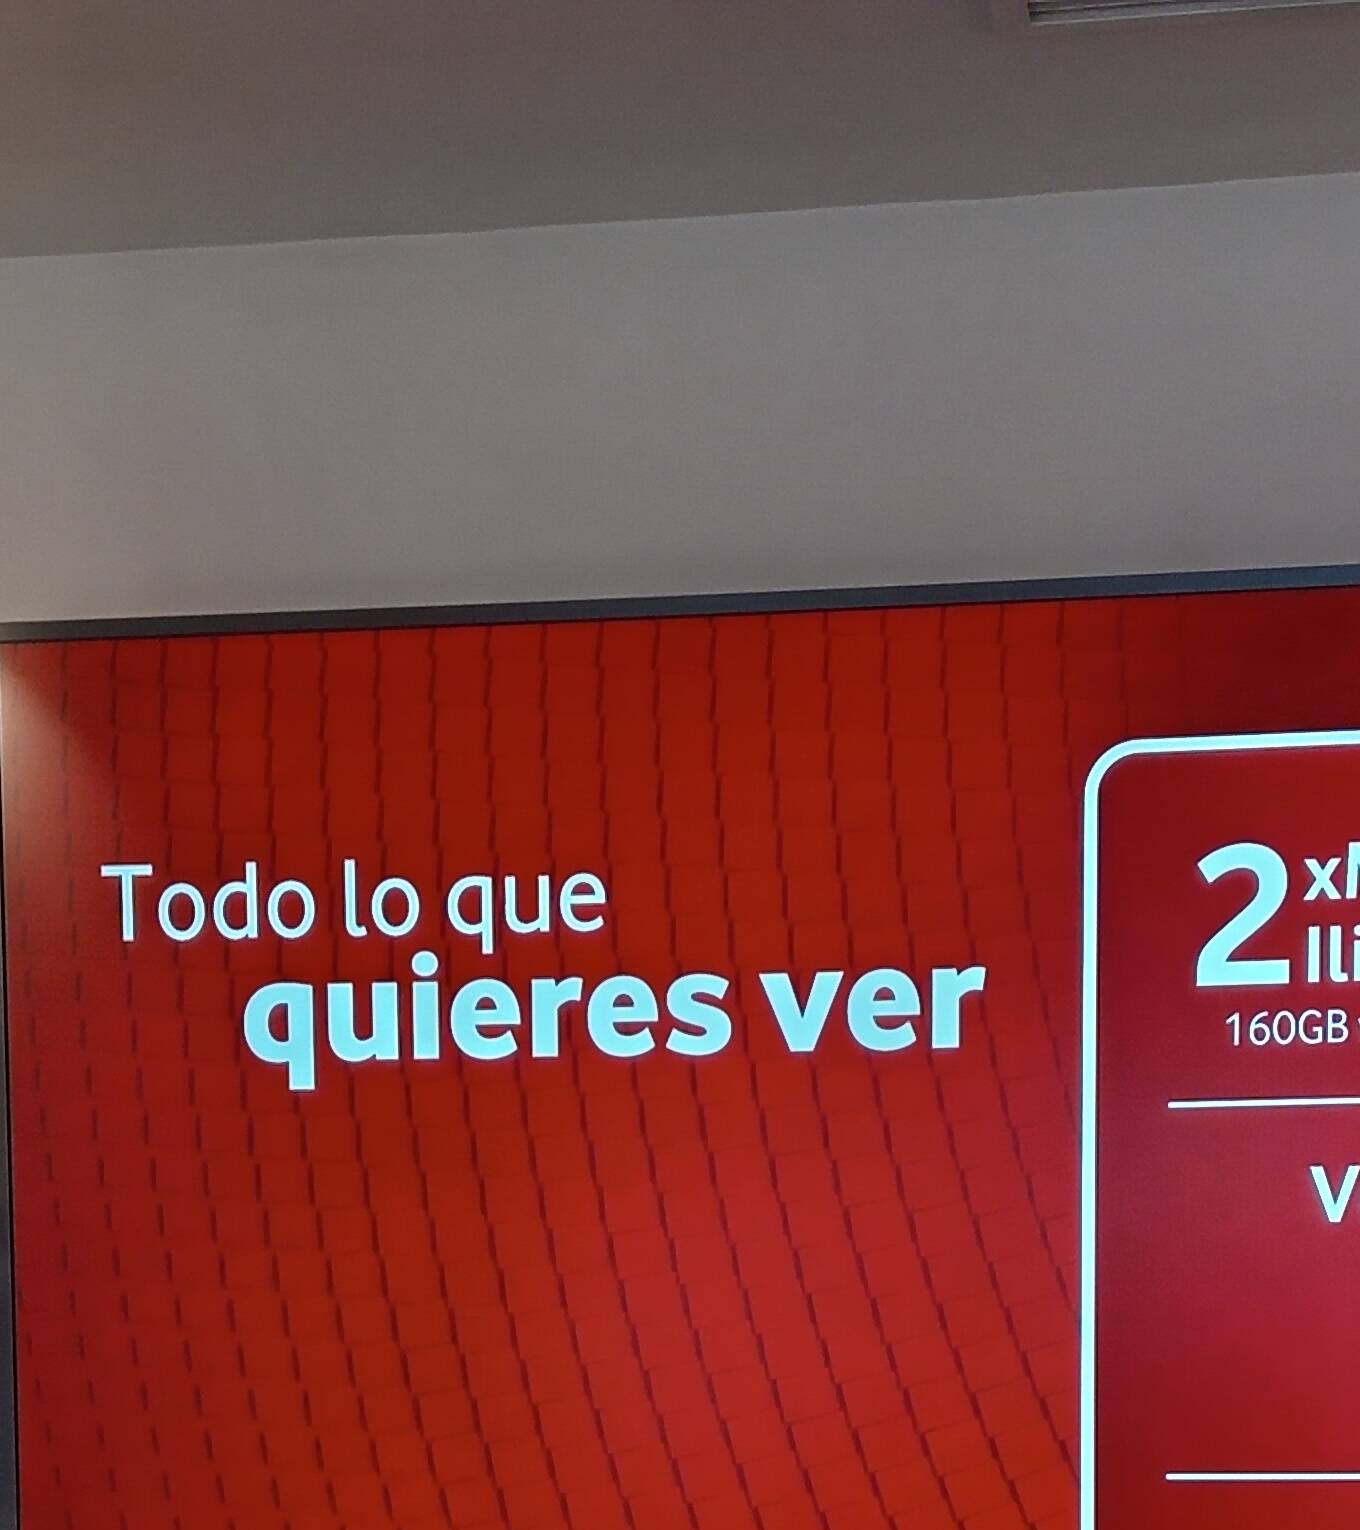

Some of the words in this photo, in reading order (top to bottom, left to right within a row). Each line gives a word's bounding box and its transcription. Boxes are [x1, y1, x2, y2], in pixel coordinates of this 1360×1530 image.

[100, 861, 316, 942] Todo
[344, 858, 420, 937] lo
[447, 872, 606, 955] que
[1195, 842, 1290, 987] 2
[243, 951, 732, 1091] quieres
[758, 966, 987, 1053] ver
[1225, 1008, 1349, 1046] 160GB
